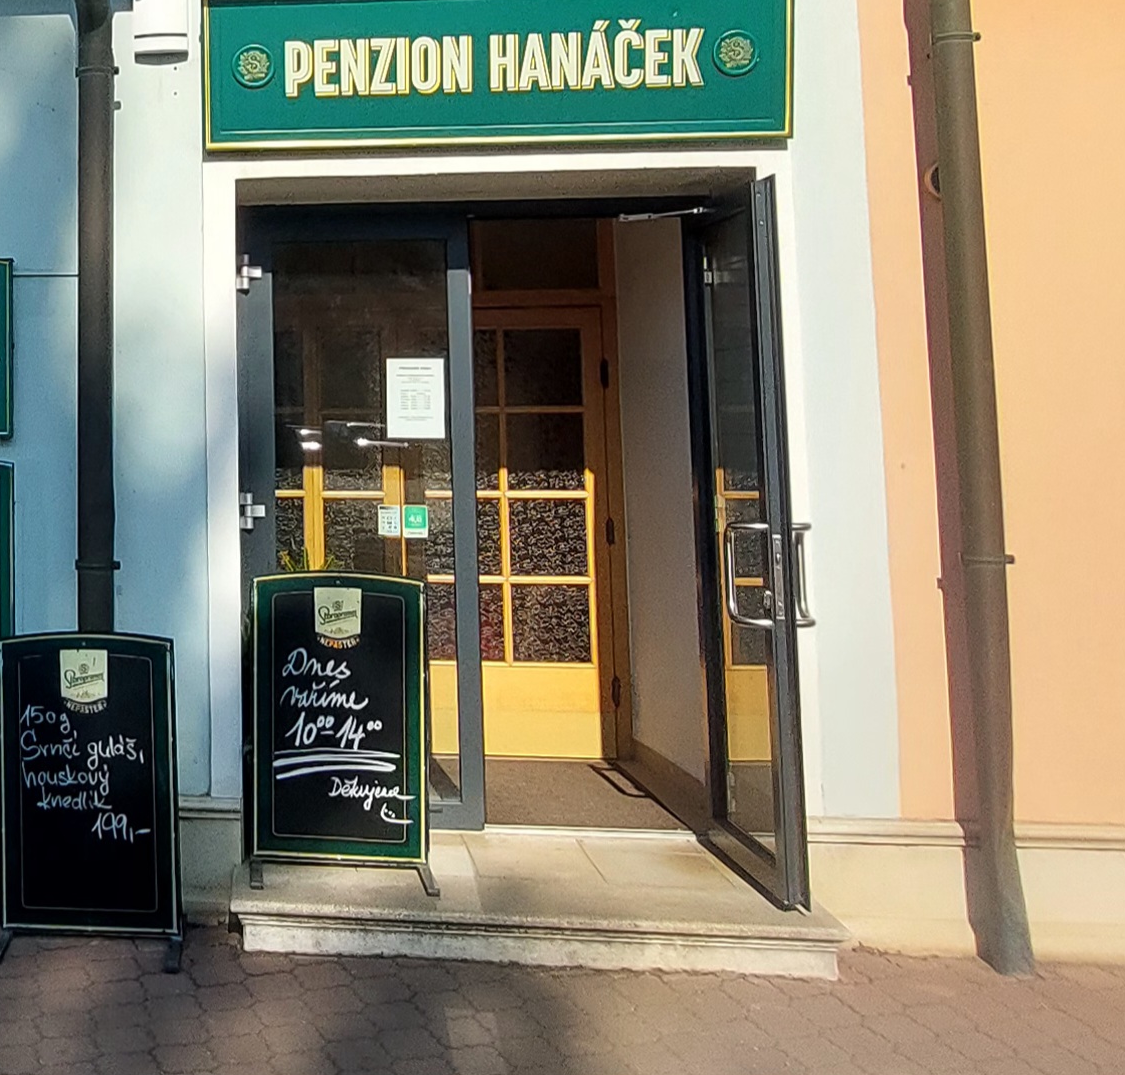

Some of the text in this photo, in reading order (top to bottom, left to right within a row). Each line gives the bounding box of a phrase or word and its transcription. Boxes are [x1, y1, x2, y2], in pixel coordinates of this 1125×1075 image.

[284, 19, 705, 97] PENZION HANÁČEK
[282, 647, 351, 680] Dnes
[280, 680, 369, 710] vaříme
[87, 734, 144, 771] guláš,
[22, 761, 109, 796] houskový
